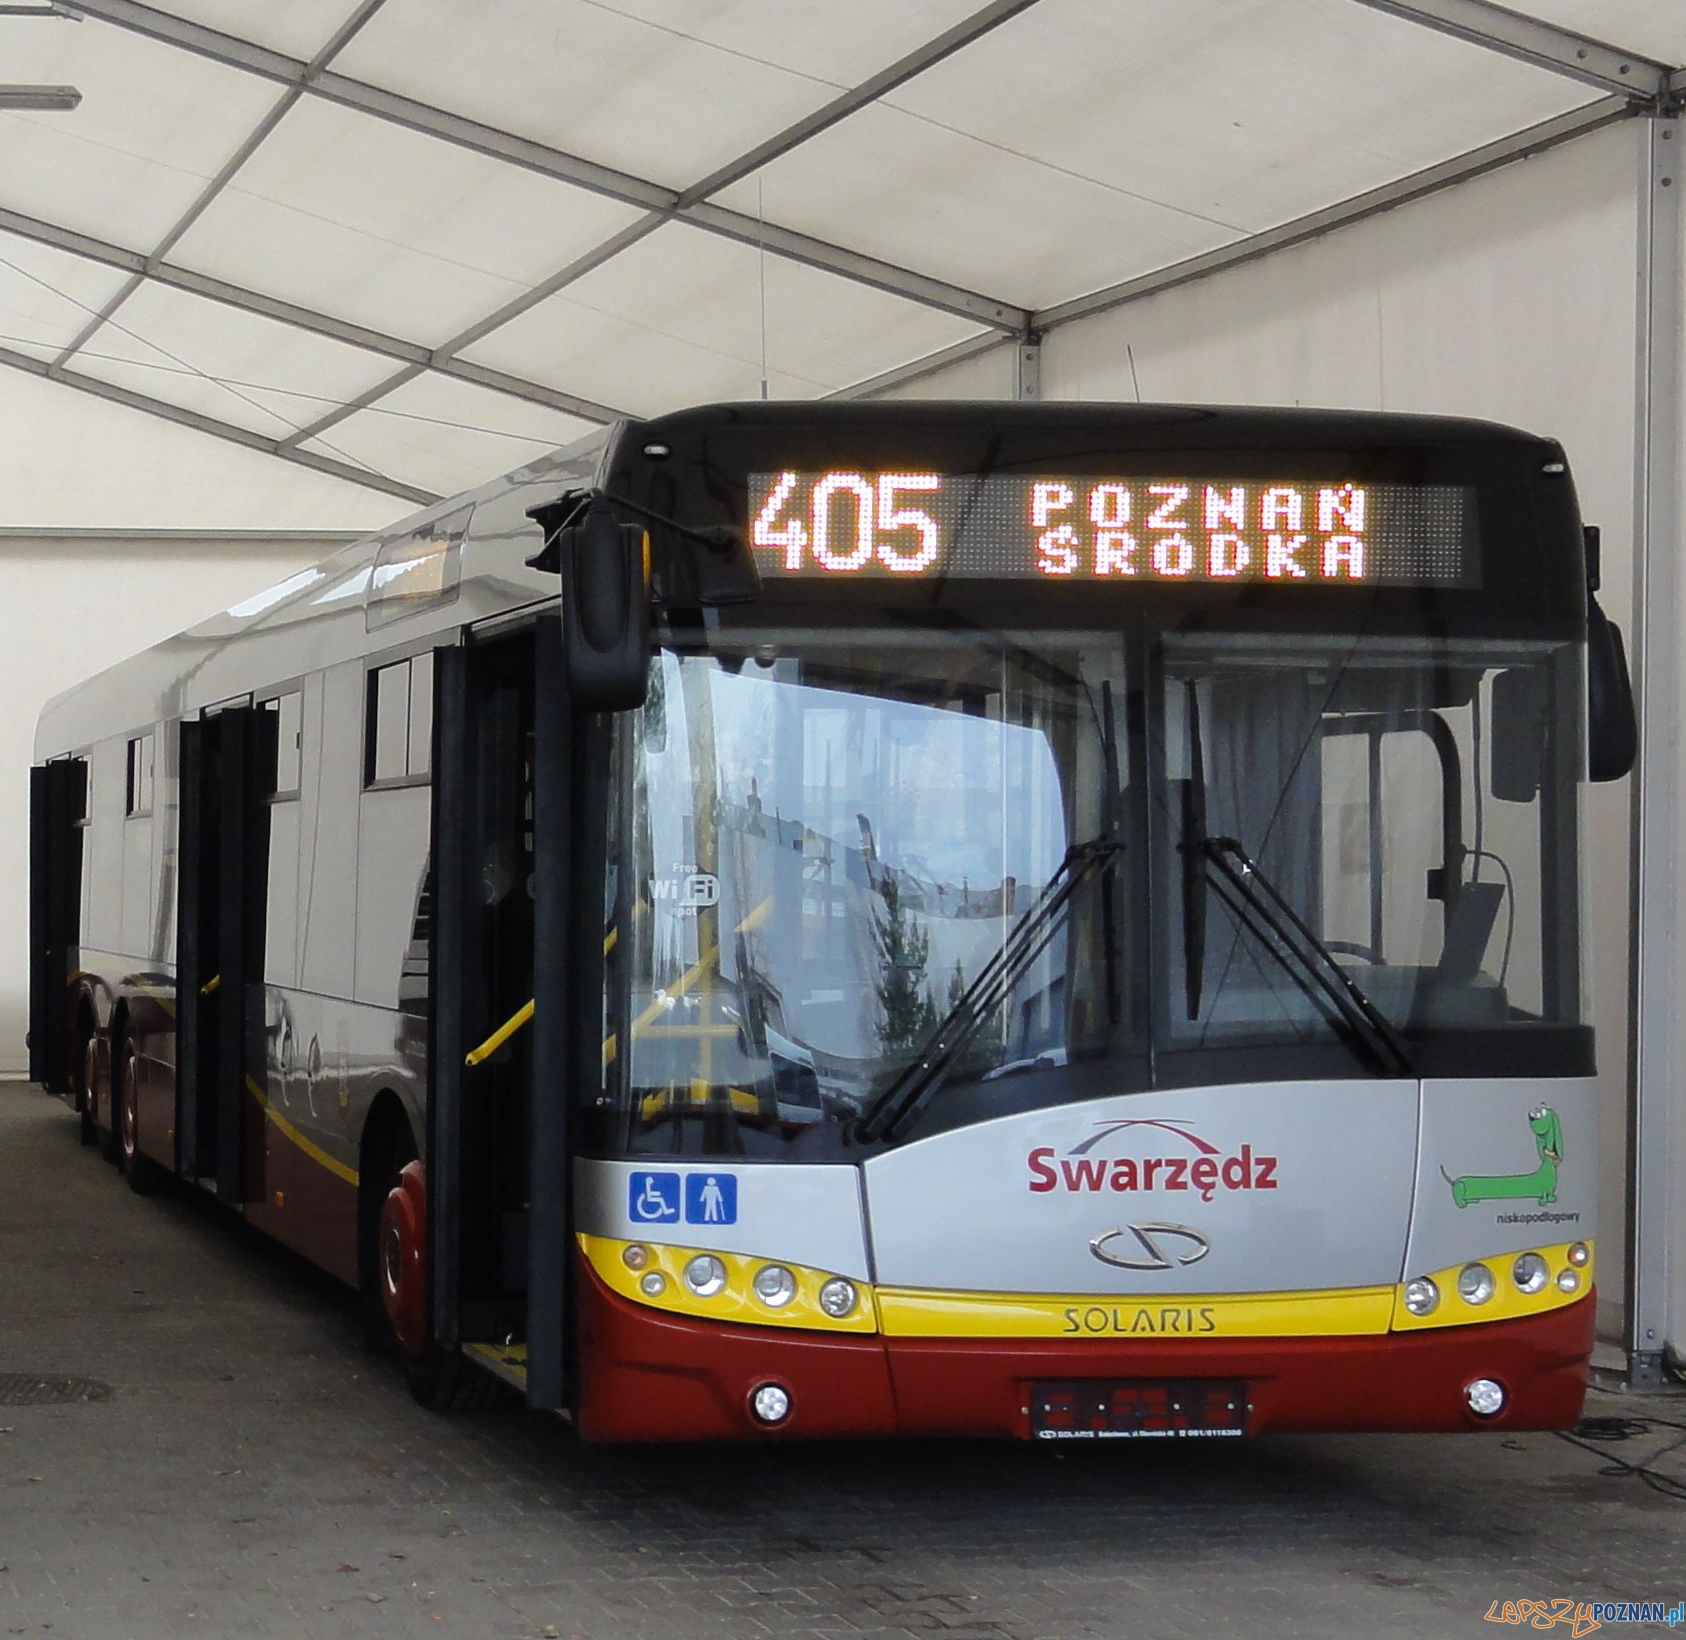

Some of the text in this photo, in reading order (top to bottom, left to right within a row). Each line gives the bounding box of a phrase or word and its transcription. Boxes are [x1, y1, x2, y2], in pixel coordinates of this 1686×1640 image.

[752, 471, 939, 572] 405
[1031, 482, 1366, 532] POZNAŃ
[672, 862, 699, 873] Free
[1026, 1143, 1279, 1203] Swarzędz
[1063, 1306, 1217, 1334] SOLARIS
